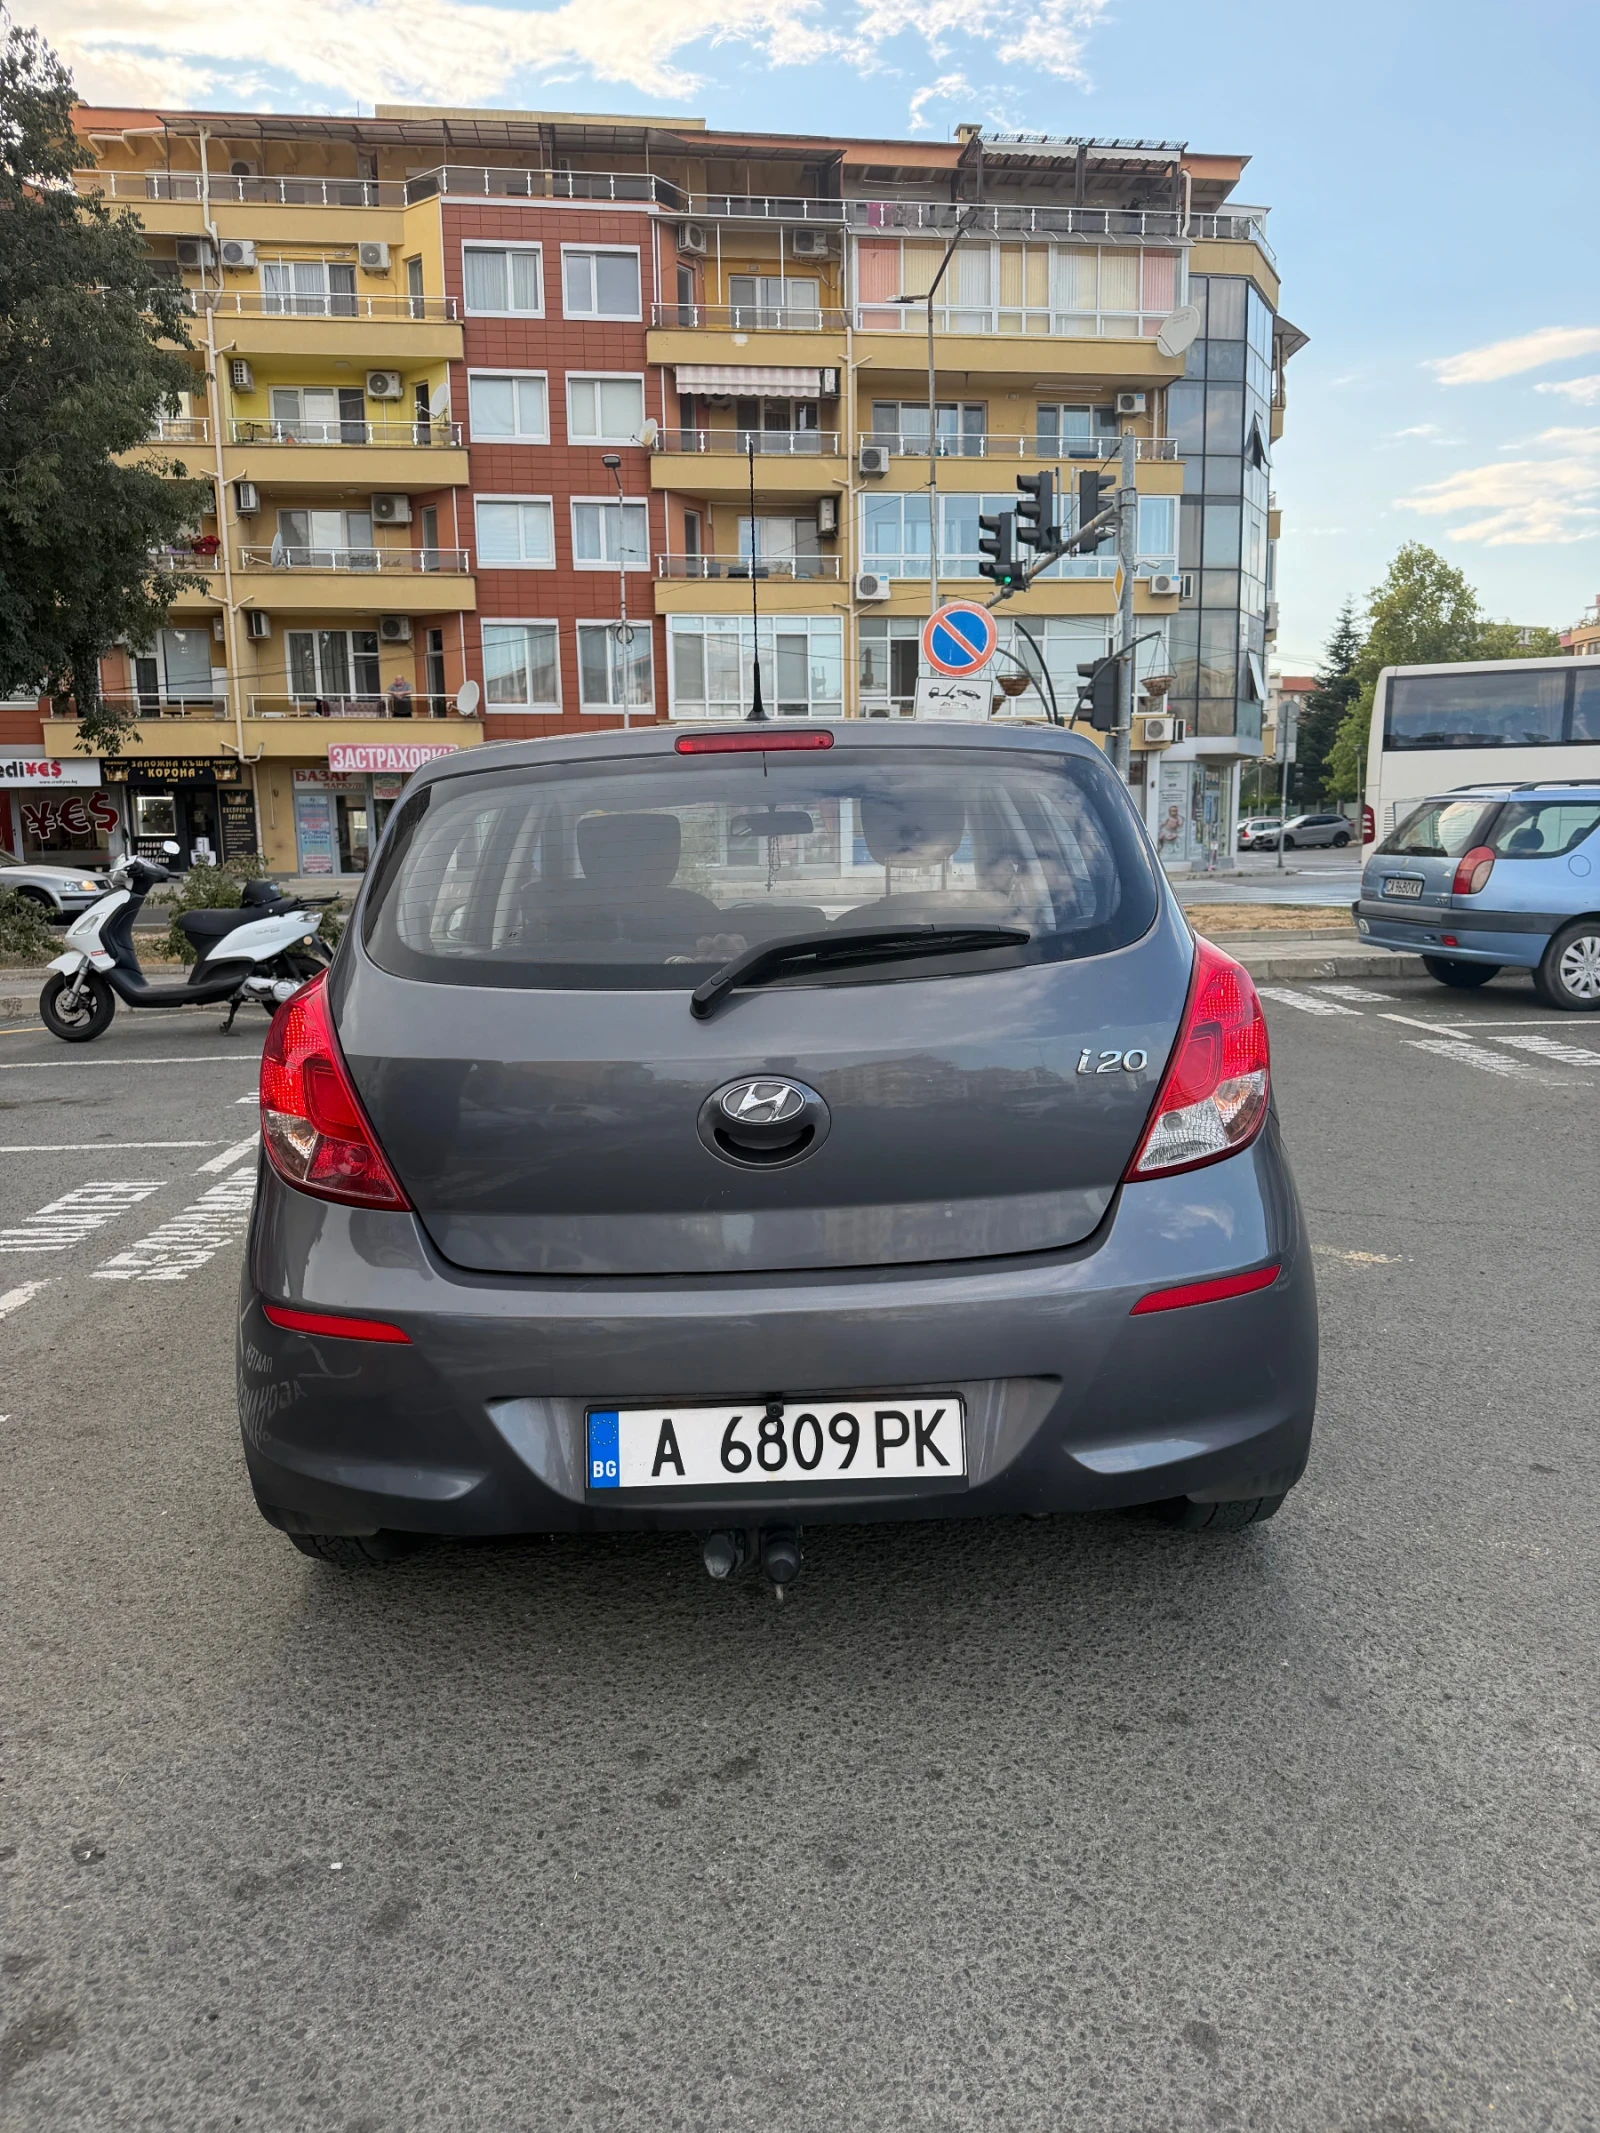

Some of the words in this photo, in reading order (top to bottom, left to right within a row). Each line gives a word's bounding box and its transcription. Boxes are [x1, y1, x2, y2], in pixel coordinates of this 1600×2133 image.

[131, 760, 178, 768] ЗАЛОЖНА
[333, 748, 454, 768] ЗАСТРАХОВ
[147, 768, 195, 778] КОРОНА
[295, 771, 352, 782] БАЗАР
[1077, 1048, 1148, 1074] i20
[592, 1460, 617, 1479] BG
